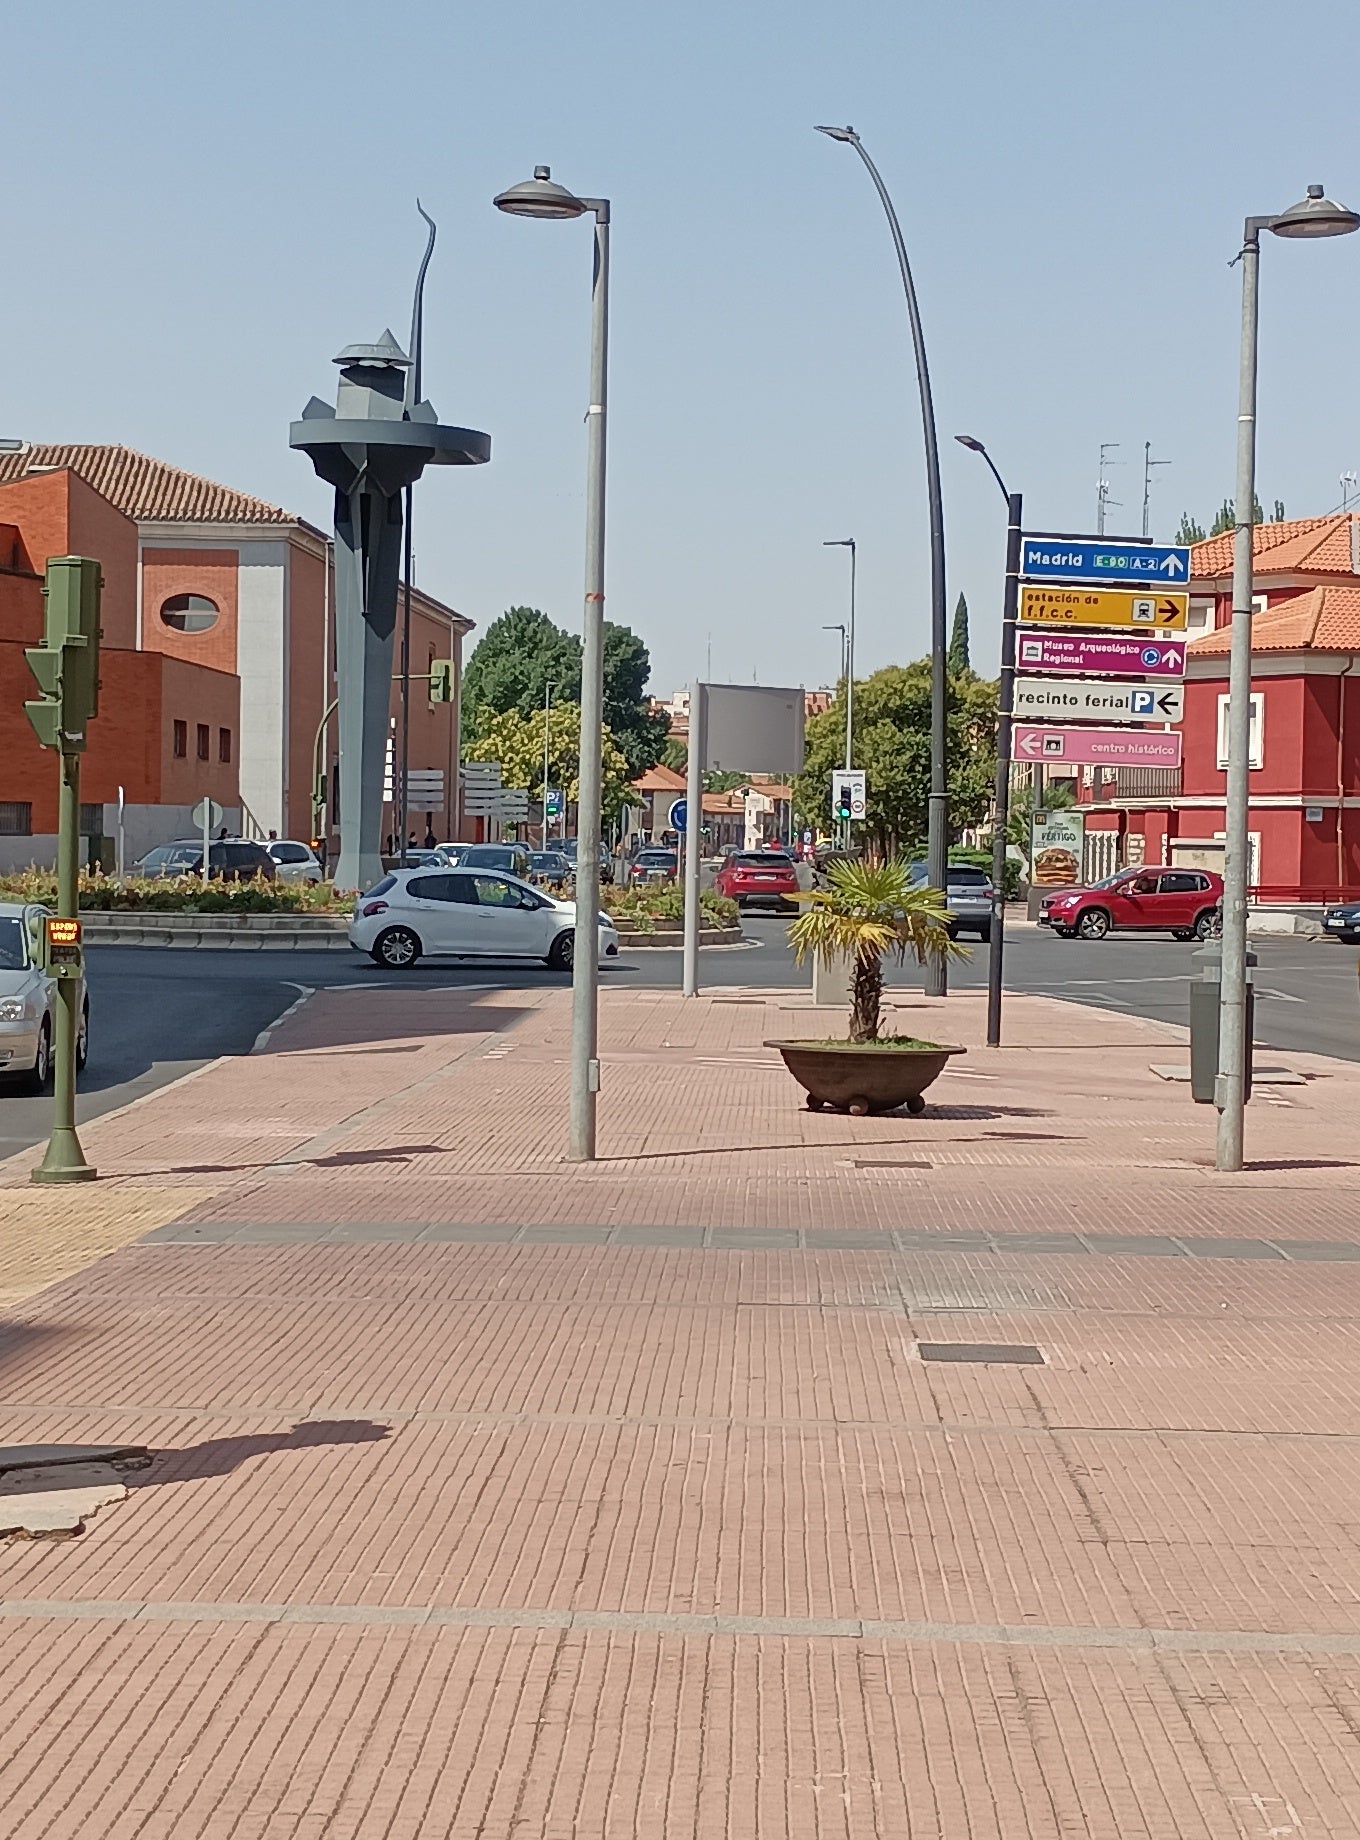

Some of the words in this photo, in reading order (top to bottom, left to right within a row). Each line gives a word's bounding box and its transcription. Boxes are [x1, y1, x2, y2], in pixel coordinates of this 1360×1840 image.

[1028, 551, 1083, 567] Madrid
[1096, 556, 1126, 568] E-90
[1133, 558, 1156, 569] A-2
[1027, 593, 1080, 604] estación
[1084, 595, 1099, 605] de
[1027, 605, 1078, 619] f.f.c.c.
[1044, 640, 1074, 651] Museo
[1079, 642, 1140, 655] Arqueológico
[1043, 652, 1084, 665] Regional
[1018, 691, 1078, 706] recinto
[1085, 694, 1129, 709] ferial
[1134, 692, 1151, 712] P
[1091, 743, 1125, 754] centro
[1127, 743, 1175, 755] histórico
